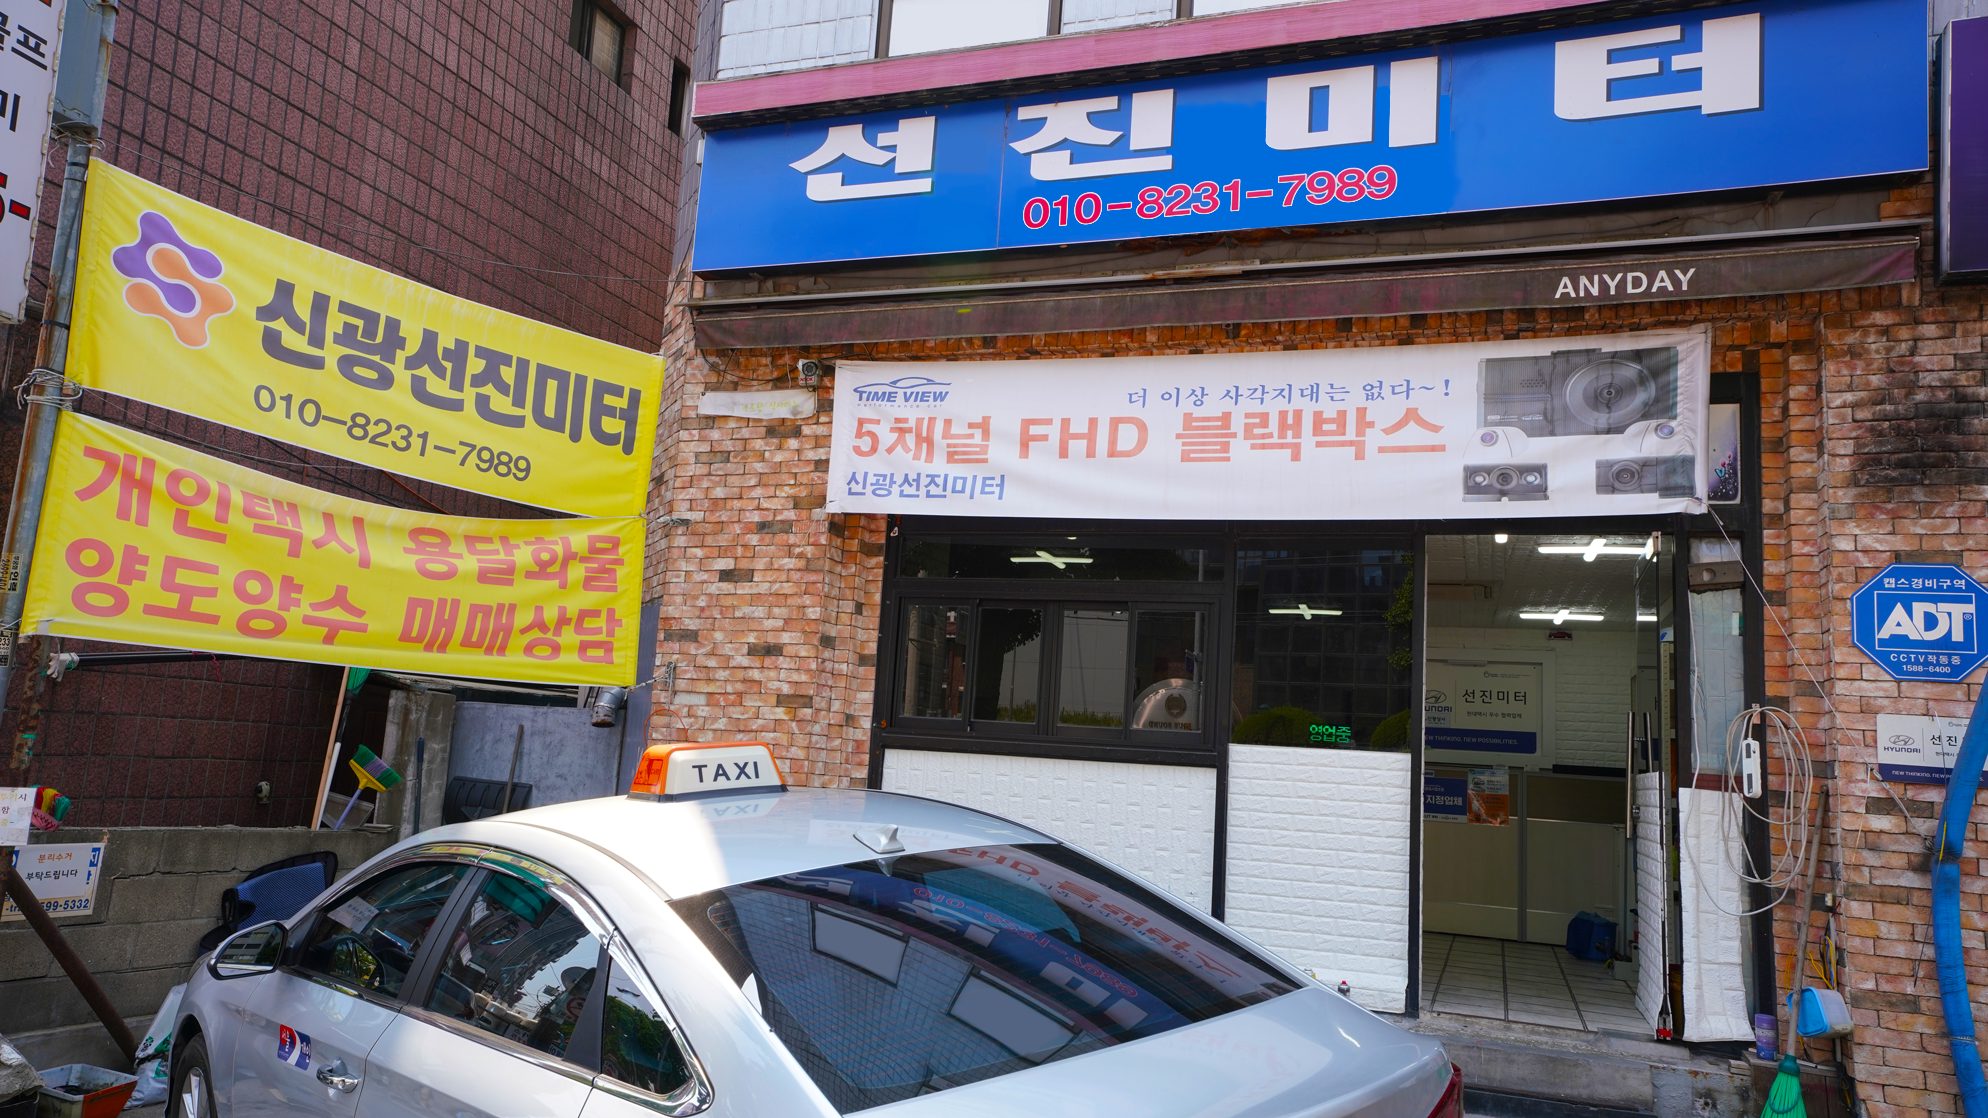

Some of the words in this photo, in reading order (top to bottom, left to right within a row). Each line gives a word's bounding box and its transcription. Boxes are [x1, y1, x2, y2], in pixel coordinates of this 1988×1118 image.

[788, 12, 1762, 203] 선진미터
[1022, 164, 1399, 231] 010-8231-7989
[1554, 266, 1697, 299] ANYDAY
[255, 277, 642, 456] 신광선진미터
[854, 390, 899, 403] TIME
[902, 390, 950, 403] VIEW
[1126, 386, 1146, 409] 더
[1161, 385, 1209, 408] 이상
[1218, 381, 1351, 407] 사각지대는
[253, 384, 532, 482] 010-8231-7989
[852, 415, 993, 465] 5채널
[1018, 415, 1149, 460] FHD
[1174, 406, 1448, 464] 블랙박스
[845, 471, 1007, 501] 신광선진미터
[74, 445, 373, 570] 개인택시
[402, 526, 626, 594] 용달화물
[1882, 577, 1967, 590] 캡스경비구역
[65, 537, 370, 646] 양도양수
[397, 596, 624, 665] 매매상담
[1877, 601, 1974, 642] ADT
[1890, 653, 1962, 665] CCTV작동중
[1902, 664, 1951, 673] 1588-6400
[1462, 688, 1528, 706] 선진미터
[1424, 705, 1453, 713] UNDAI
[1466, 710, 1488, 718] 현대택시
[1309, 724, 1352, 743] 영업중
[1477, 737, 1519, 745] POSSIBILITIES.
[1930, 734, 1958, 747] 선진
[691, 760, 760, 783] TAXI
[1425, 794, 1463, 806] 지정업체
[37, 852, 73, 864] 분리수거
[25, 868, 79, 881] 부탁드립니다
